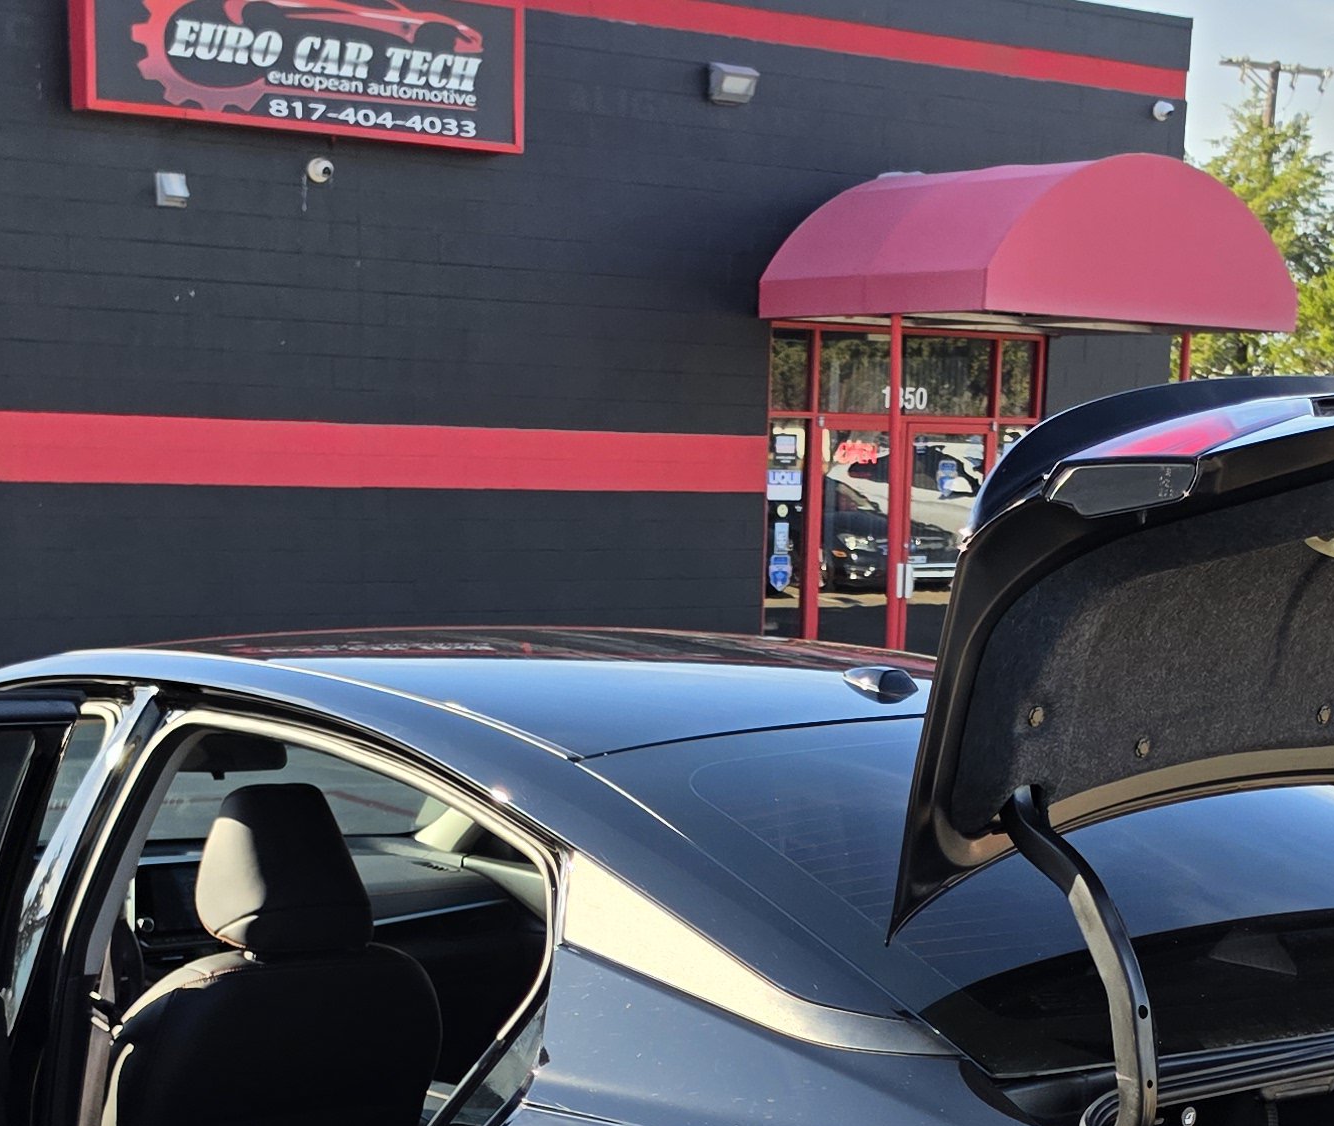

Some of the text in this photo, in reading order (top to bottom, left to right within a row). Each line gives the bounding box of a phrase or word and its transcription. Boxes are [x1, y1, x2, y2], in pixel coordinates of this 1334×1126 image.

[167, 18, 483, 93] EURO CAR TECH
[267, 70, 478, 108] european automotive
[268, 98, 478, 139] 817-404-4033
